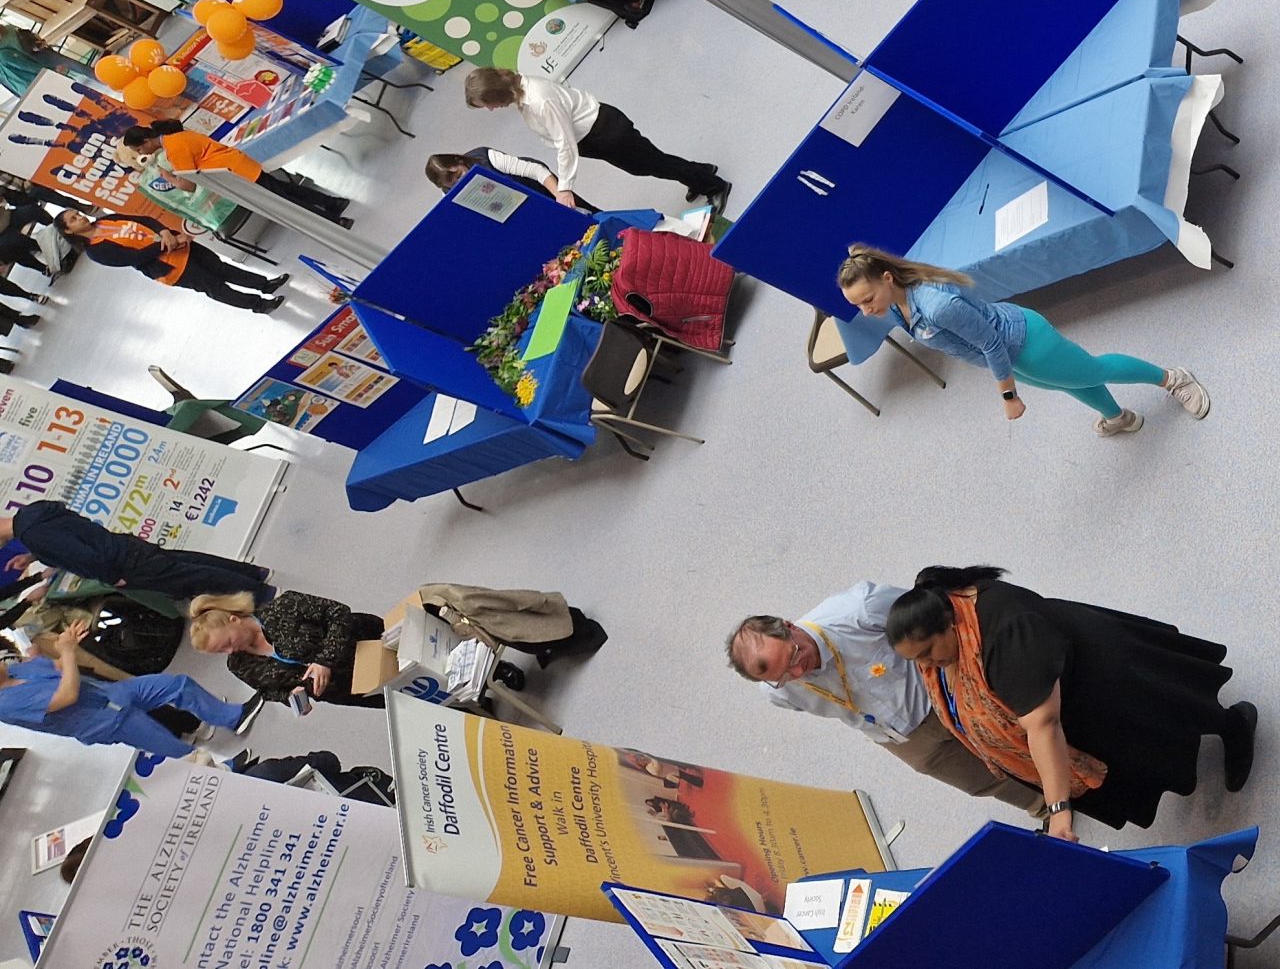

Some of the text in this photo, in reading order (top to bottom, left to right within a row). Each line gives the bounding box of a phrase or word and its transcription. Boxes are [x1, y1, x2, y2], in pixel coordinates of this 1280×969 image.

[56, 132, 107, 186] Clean
[95, 161, 130, 200] sav
[108, 170, 143, 207] live
[315, 333, 337, 347] Sun
[0, 388, 14, 417] even
[18, 406, 38, 428] five
[47, 406, 85, 435] 13
[36, 440, 68, 454] 1
[70, 423, 122, 513] THMA IN IRELAND
[15, 464, 54, 494] 10
[85, 427, 149, 526] 90,000
[185, 477, 215, 522] €1,242
[138, 518, 156, 541] 000
[169, 500, 183, 512] 14
[157, 522, 173, 547] our
[417, 749, 435, 833] Irish Cancer Society
[435, 724, 460, 836] Daffodil Centre
[499, 725, 537, 888] Free Cancer Information
[525, 748, 558, 866] Support & Advice
[551, 791, 569, 836] Walk in
[571, 766, 599, 864] Daffodil Centre
[588, 782, 606, 838] University
[128, 774, 204, 930] THE ALZHEIMER
[148, 864, 184, 933] SOCIETY
[183, 775, 220, 847] IRELAND
[287, 803, 349, 952] www.alzheimer.ie
[756, 821, 779, 883] Opening Hours
[197, 804, 272, 969] ntact the Alzheimer
[214, 828, 283, 969] National Helpline
[239, 832, 301, 969] el: 1800 341 341
[258, 813, 328, 969] pline@alzheimer.ie
[398, 890, 415, 922] Society
